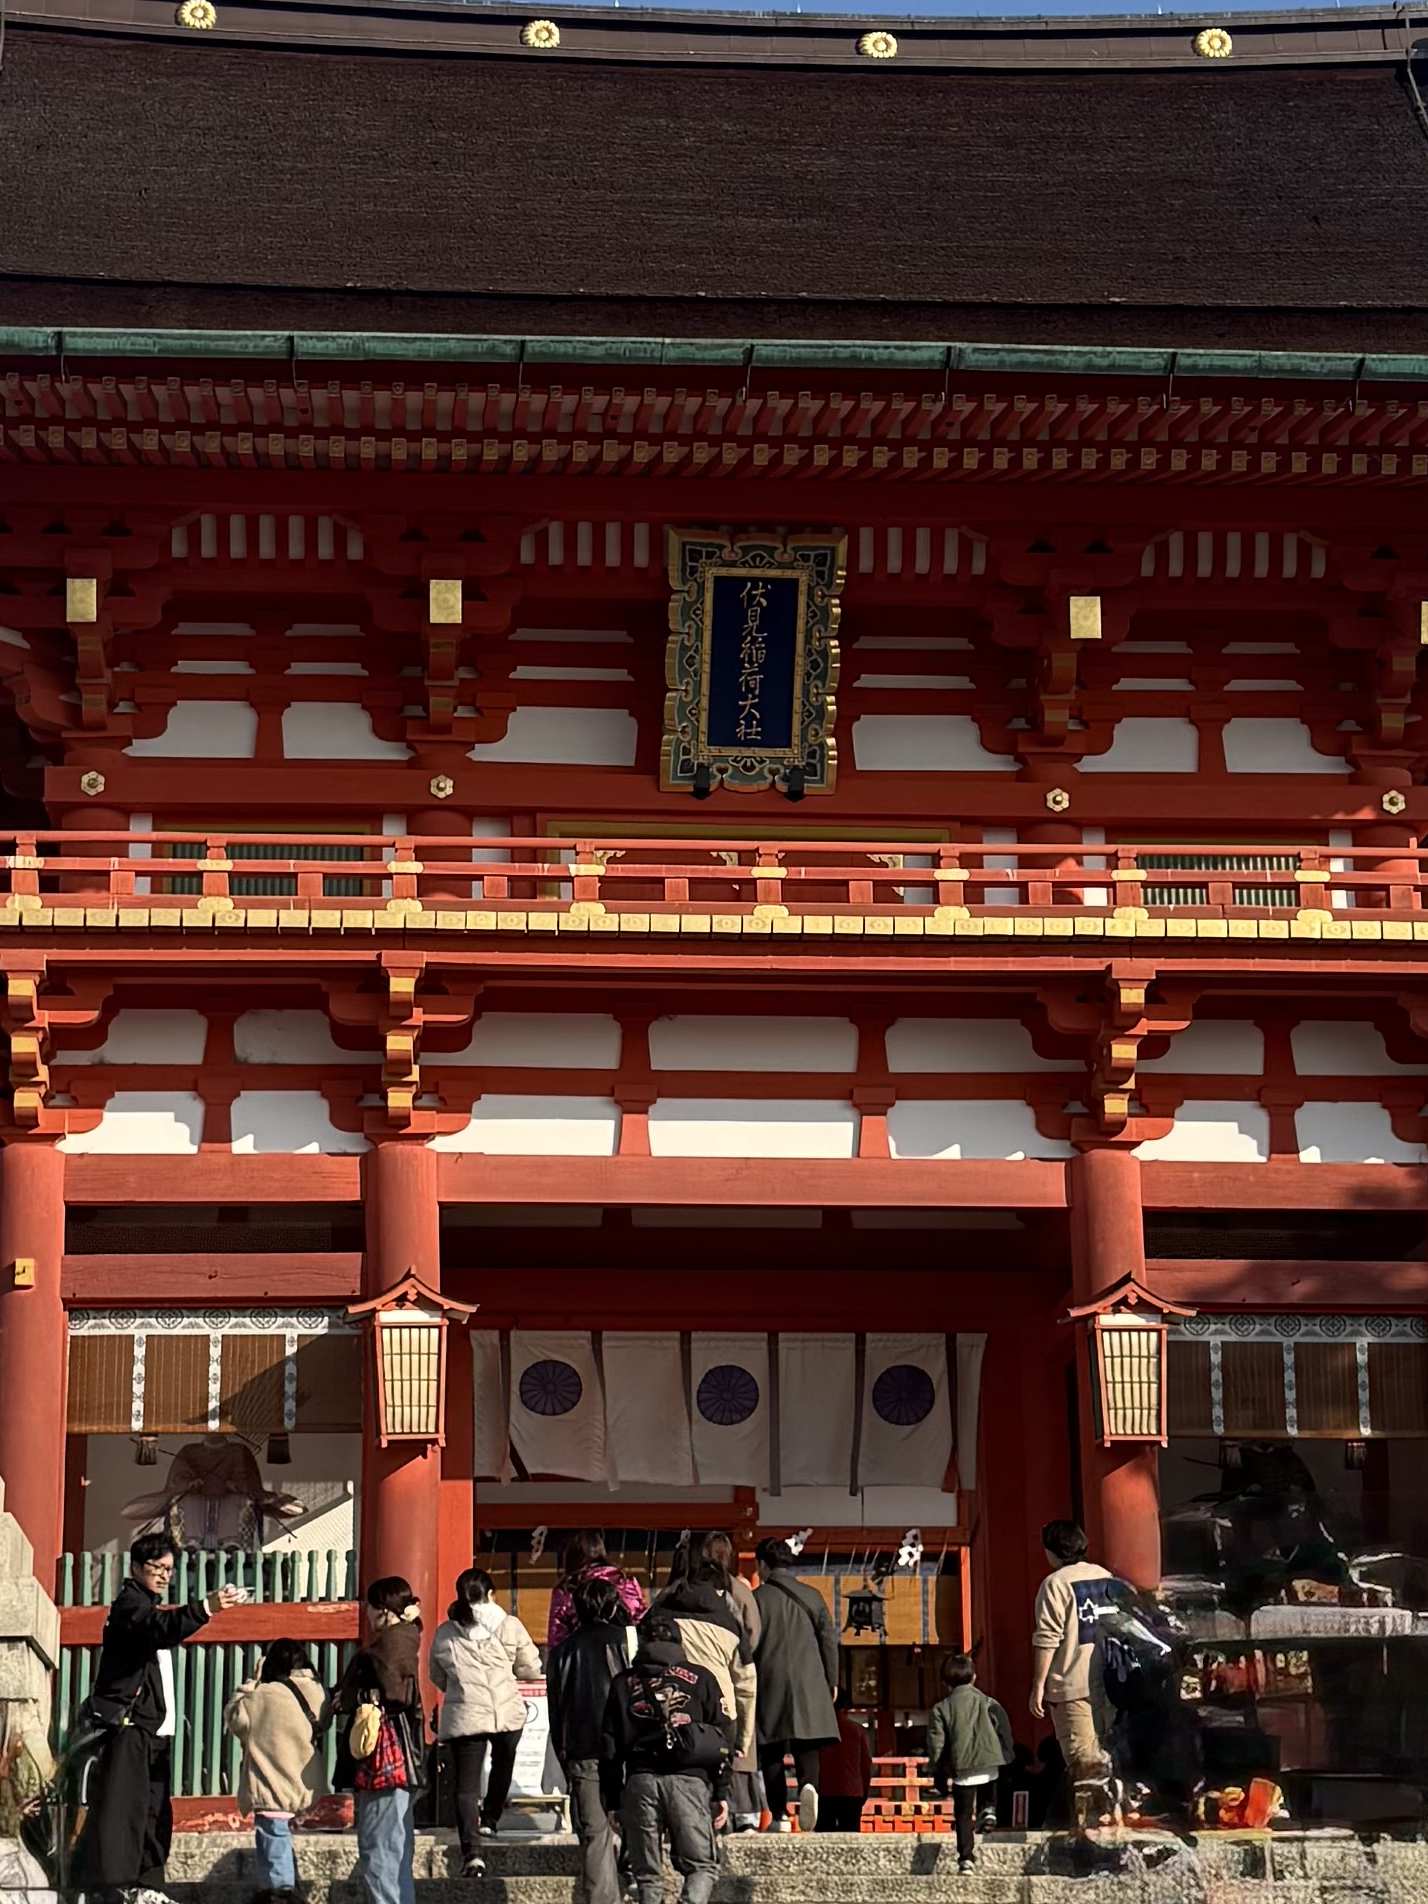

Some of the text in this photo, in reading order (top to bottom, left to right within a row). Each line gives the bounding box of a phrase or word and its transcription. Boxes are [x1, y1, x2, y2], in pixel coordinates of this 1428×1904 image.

[735, 581, 772, 741] 伏見稲荷大社
